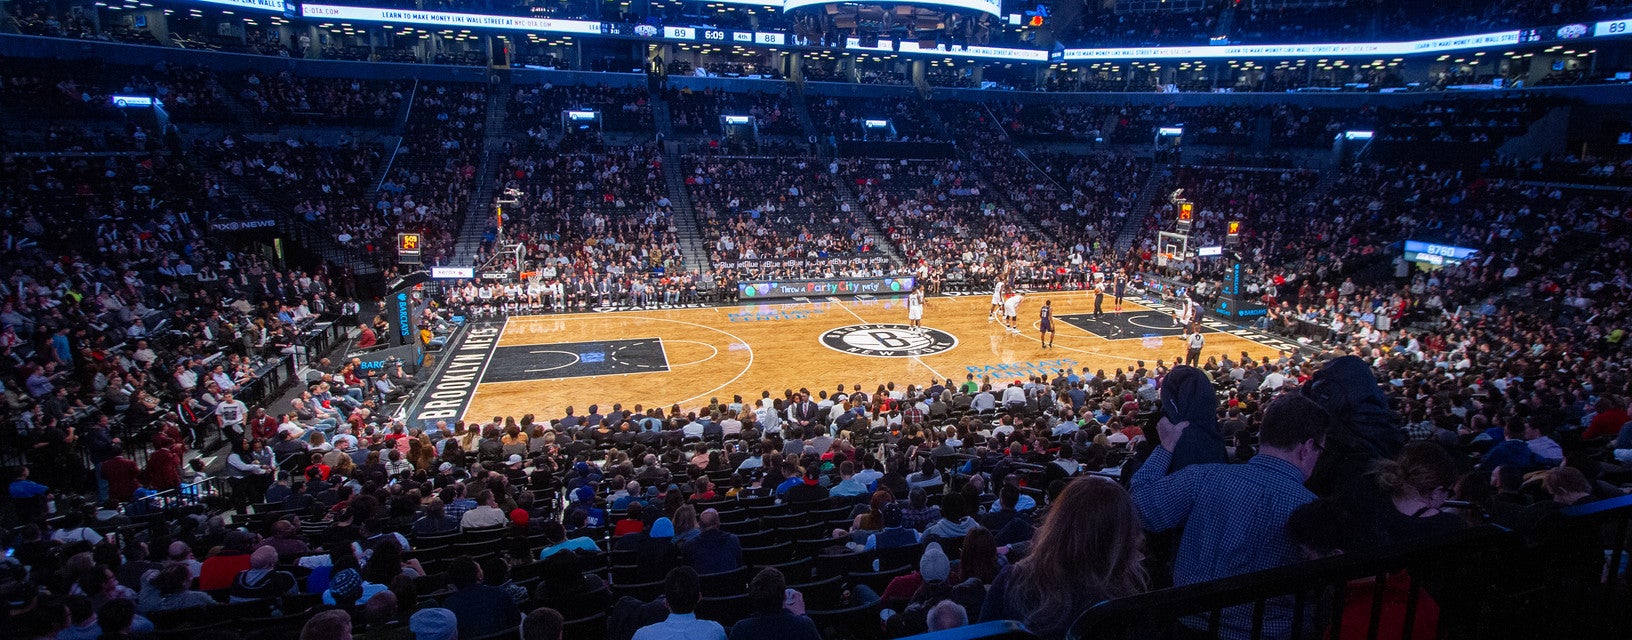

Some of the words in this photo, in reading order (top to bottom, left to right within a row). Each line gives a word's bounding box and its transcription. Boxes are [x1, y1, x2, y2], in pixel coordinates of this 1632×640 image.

[382, 11, 402, 19] LEARN
[403, 12, 412, 20] TO
[430, 14, 451, 22] MONEY
[484, 17, 505, 25] STREET
[674, 28, 686, 37] 89
[1608, 22, 1626, 33] 89
[704, 30, 725, 40] 6:09
[764, 34, 776, 43] 88
[241, 219, 276, 229] NEWS
[807, 282, 837, 294] Party
[838, 281, 859, 294] City
[400, 301, 410, 336] BARCLAYS
[868, 331, 911, 348] B
[846, 346, 894, 356] NEW
[966, 358, 1078, 373] BARCLAYS
[417, 353, 486, 420] BROOKLYN
[460, 328, 499, 350] NETS
